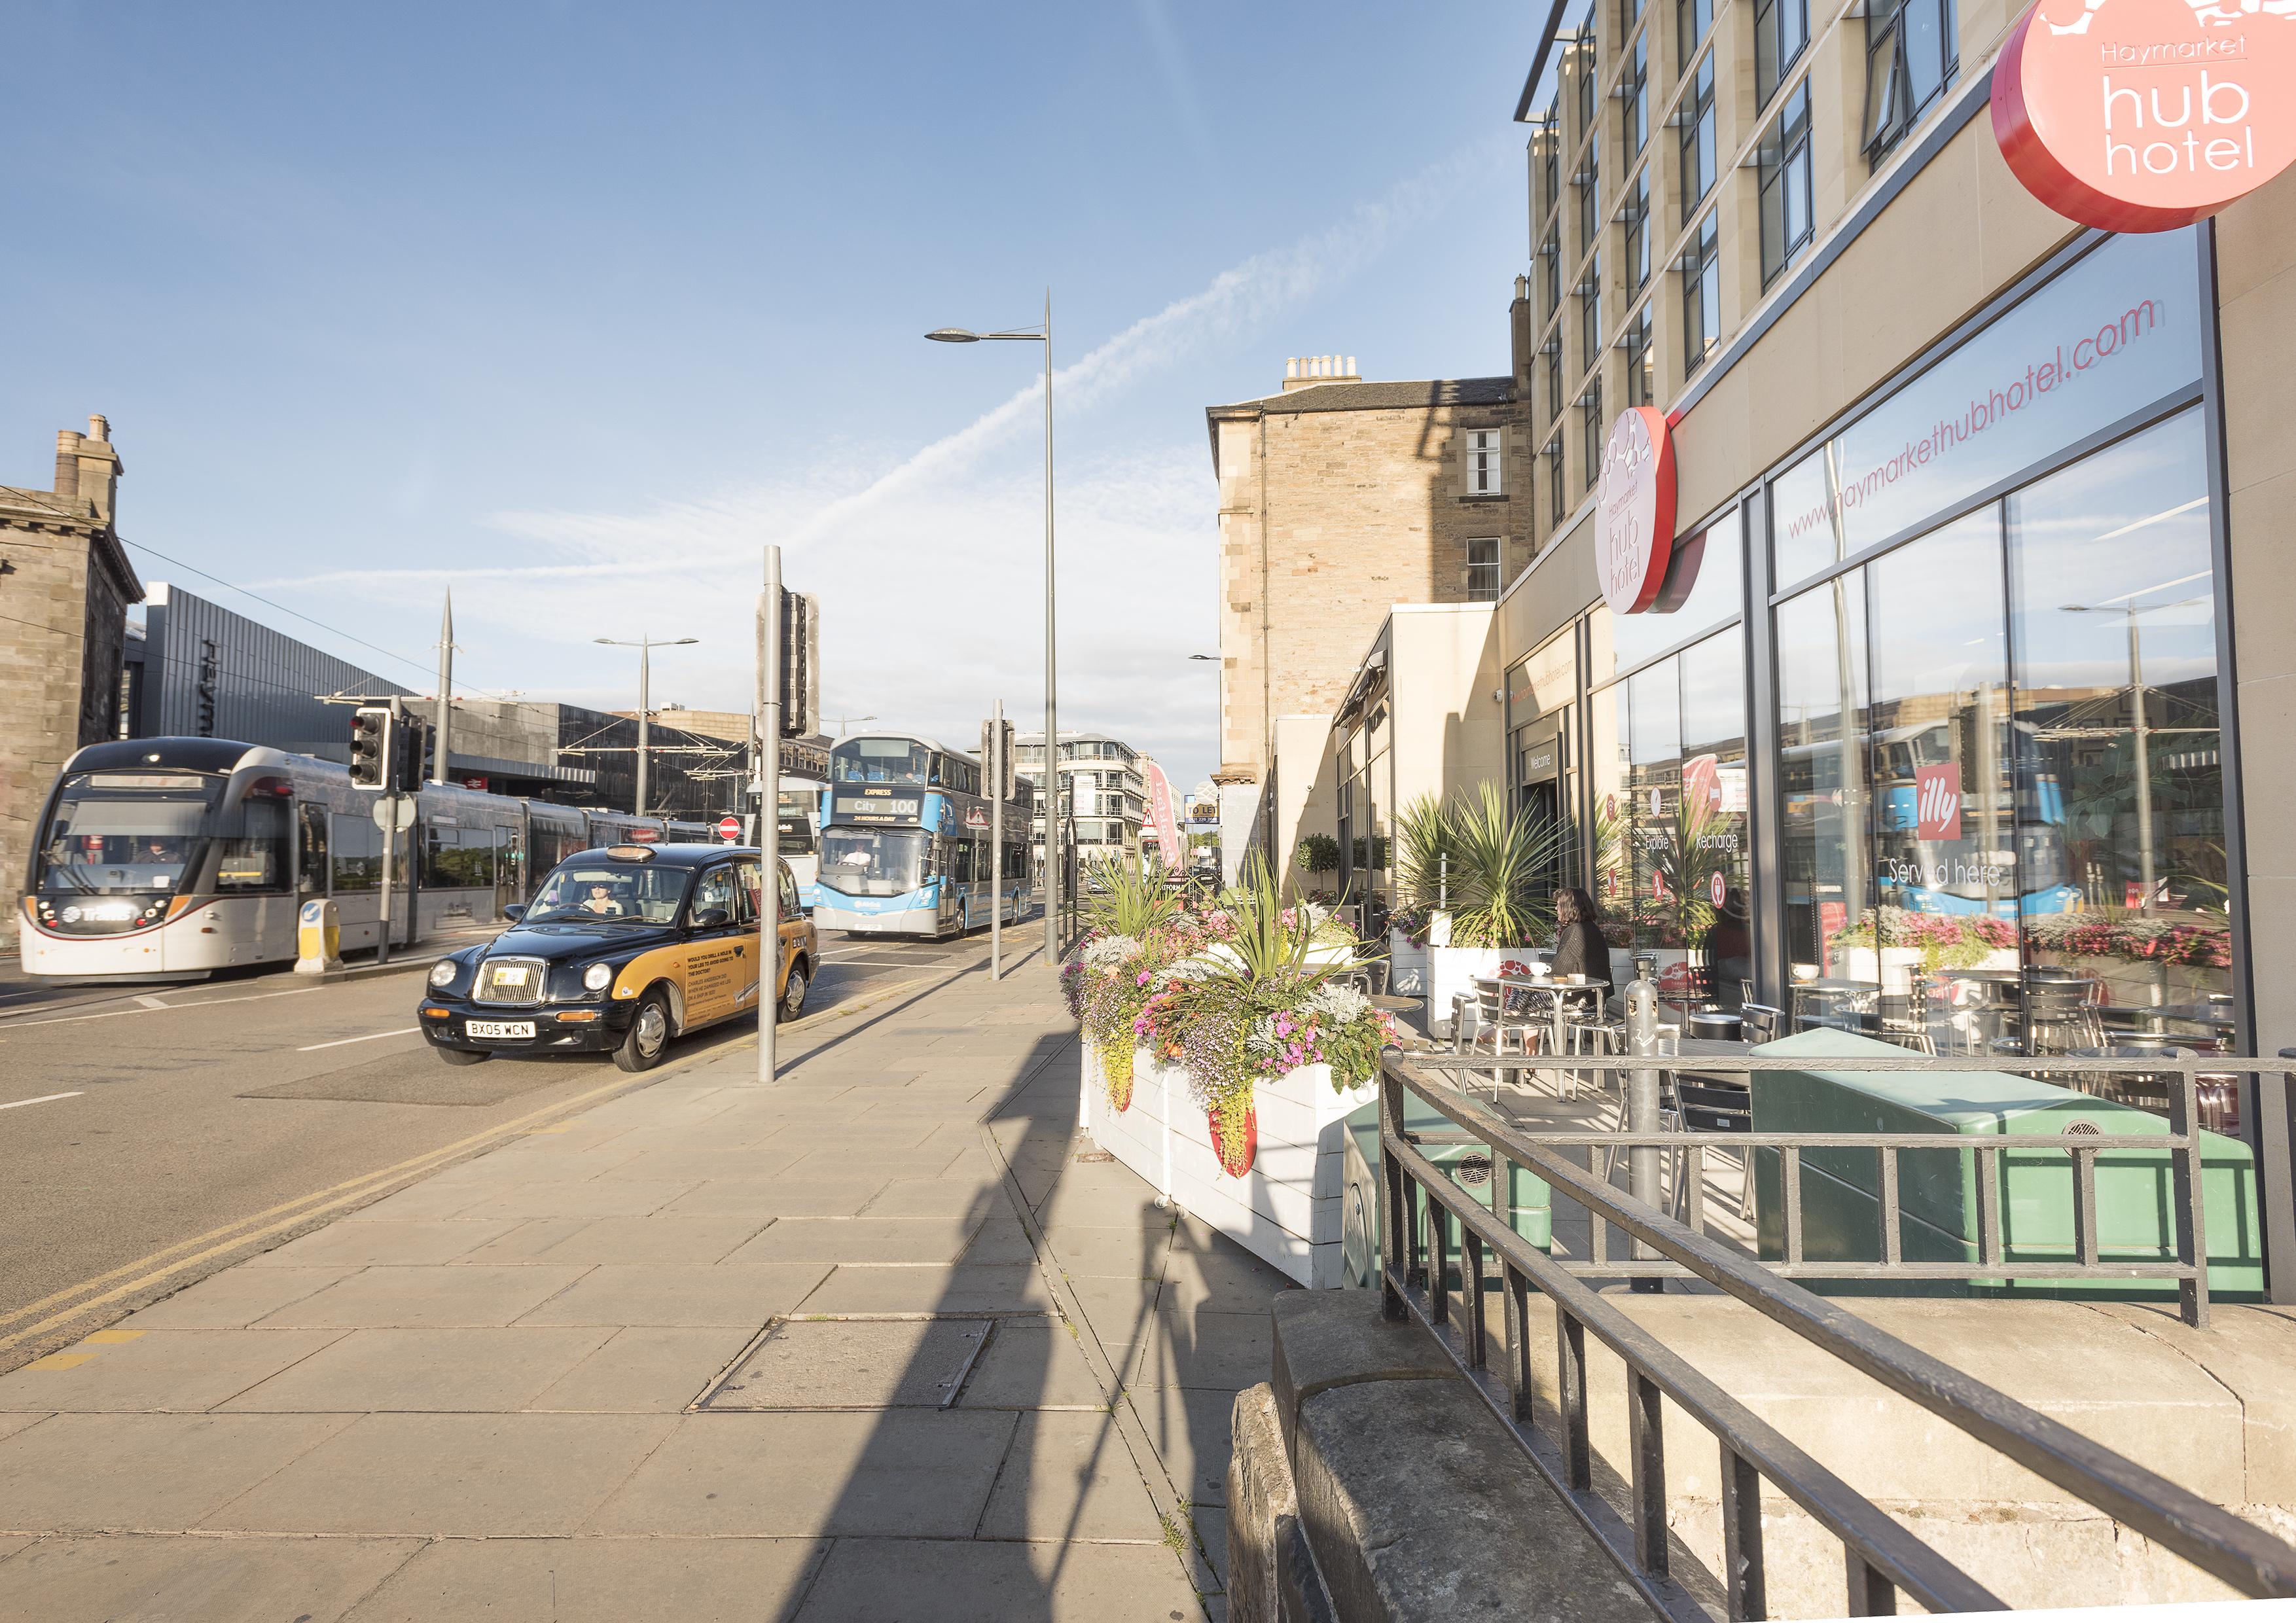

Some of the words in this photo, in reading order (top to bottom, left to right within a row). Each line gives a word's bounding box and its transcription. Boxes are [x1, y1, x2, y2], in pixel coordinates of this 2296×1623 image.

[2102, 33, 2247, 64] Haymarket
[2103, 69, 2250, 130] hub
[2106, 125, 2253, 175] hotel
[1609, 481, 1638, 518] Haymarket
[1609, 510, 1638, 565] hub
[1611, 546, 1640, 597] hotel
[1530, 753, 1551, 770] Welcome
[854, 800, 876, 812] City
[890, 800, 918, 813] 100
[1919, 776, 1957, 832] illy
[1645, 834, 1668, 853] Explore
[1696, 830, 1738, 853] Recharge
[1955, 859, 2000, 886] here
[471, 1024, 501, 1035] BX05
[505, 1025, 529, 1035] WCN
